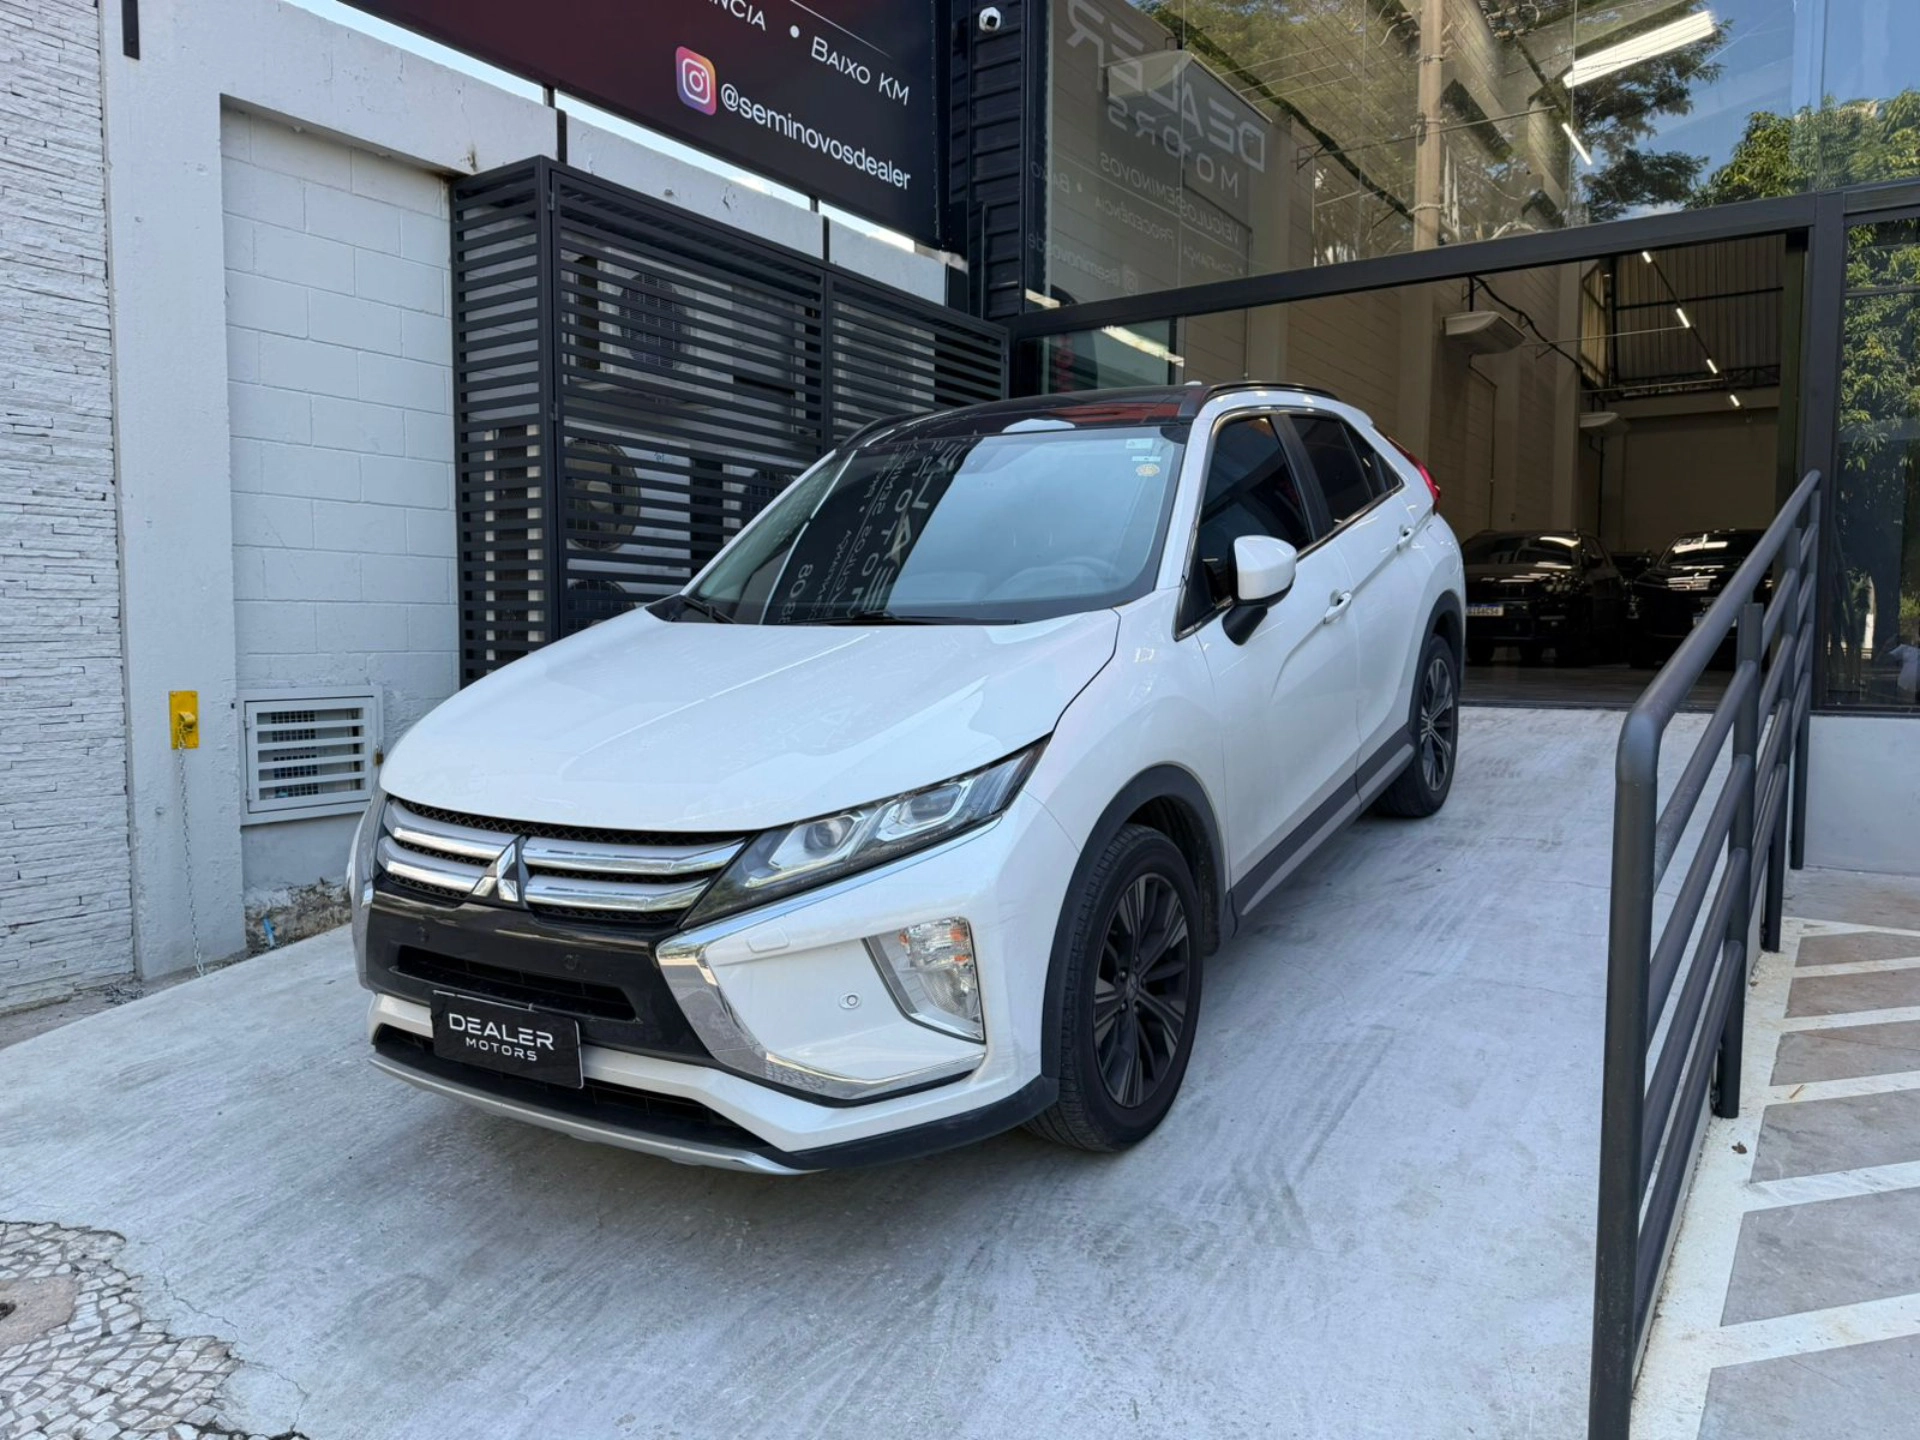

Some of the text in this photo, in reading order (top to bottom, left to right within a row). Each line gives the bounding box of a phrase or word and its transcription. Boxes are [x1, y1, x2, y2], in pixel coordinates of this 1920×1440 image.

[708, 0, 766, 31] NCIA
[878, 73, 910, 106] KM
[720, 83, 911, 190] @seminovosdealer
[448, 1012, 555, 1051] DEALER
[466, 1037, 538, 1062] MOTORS
